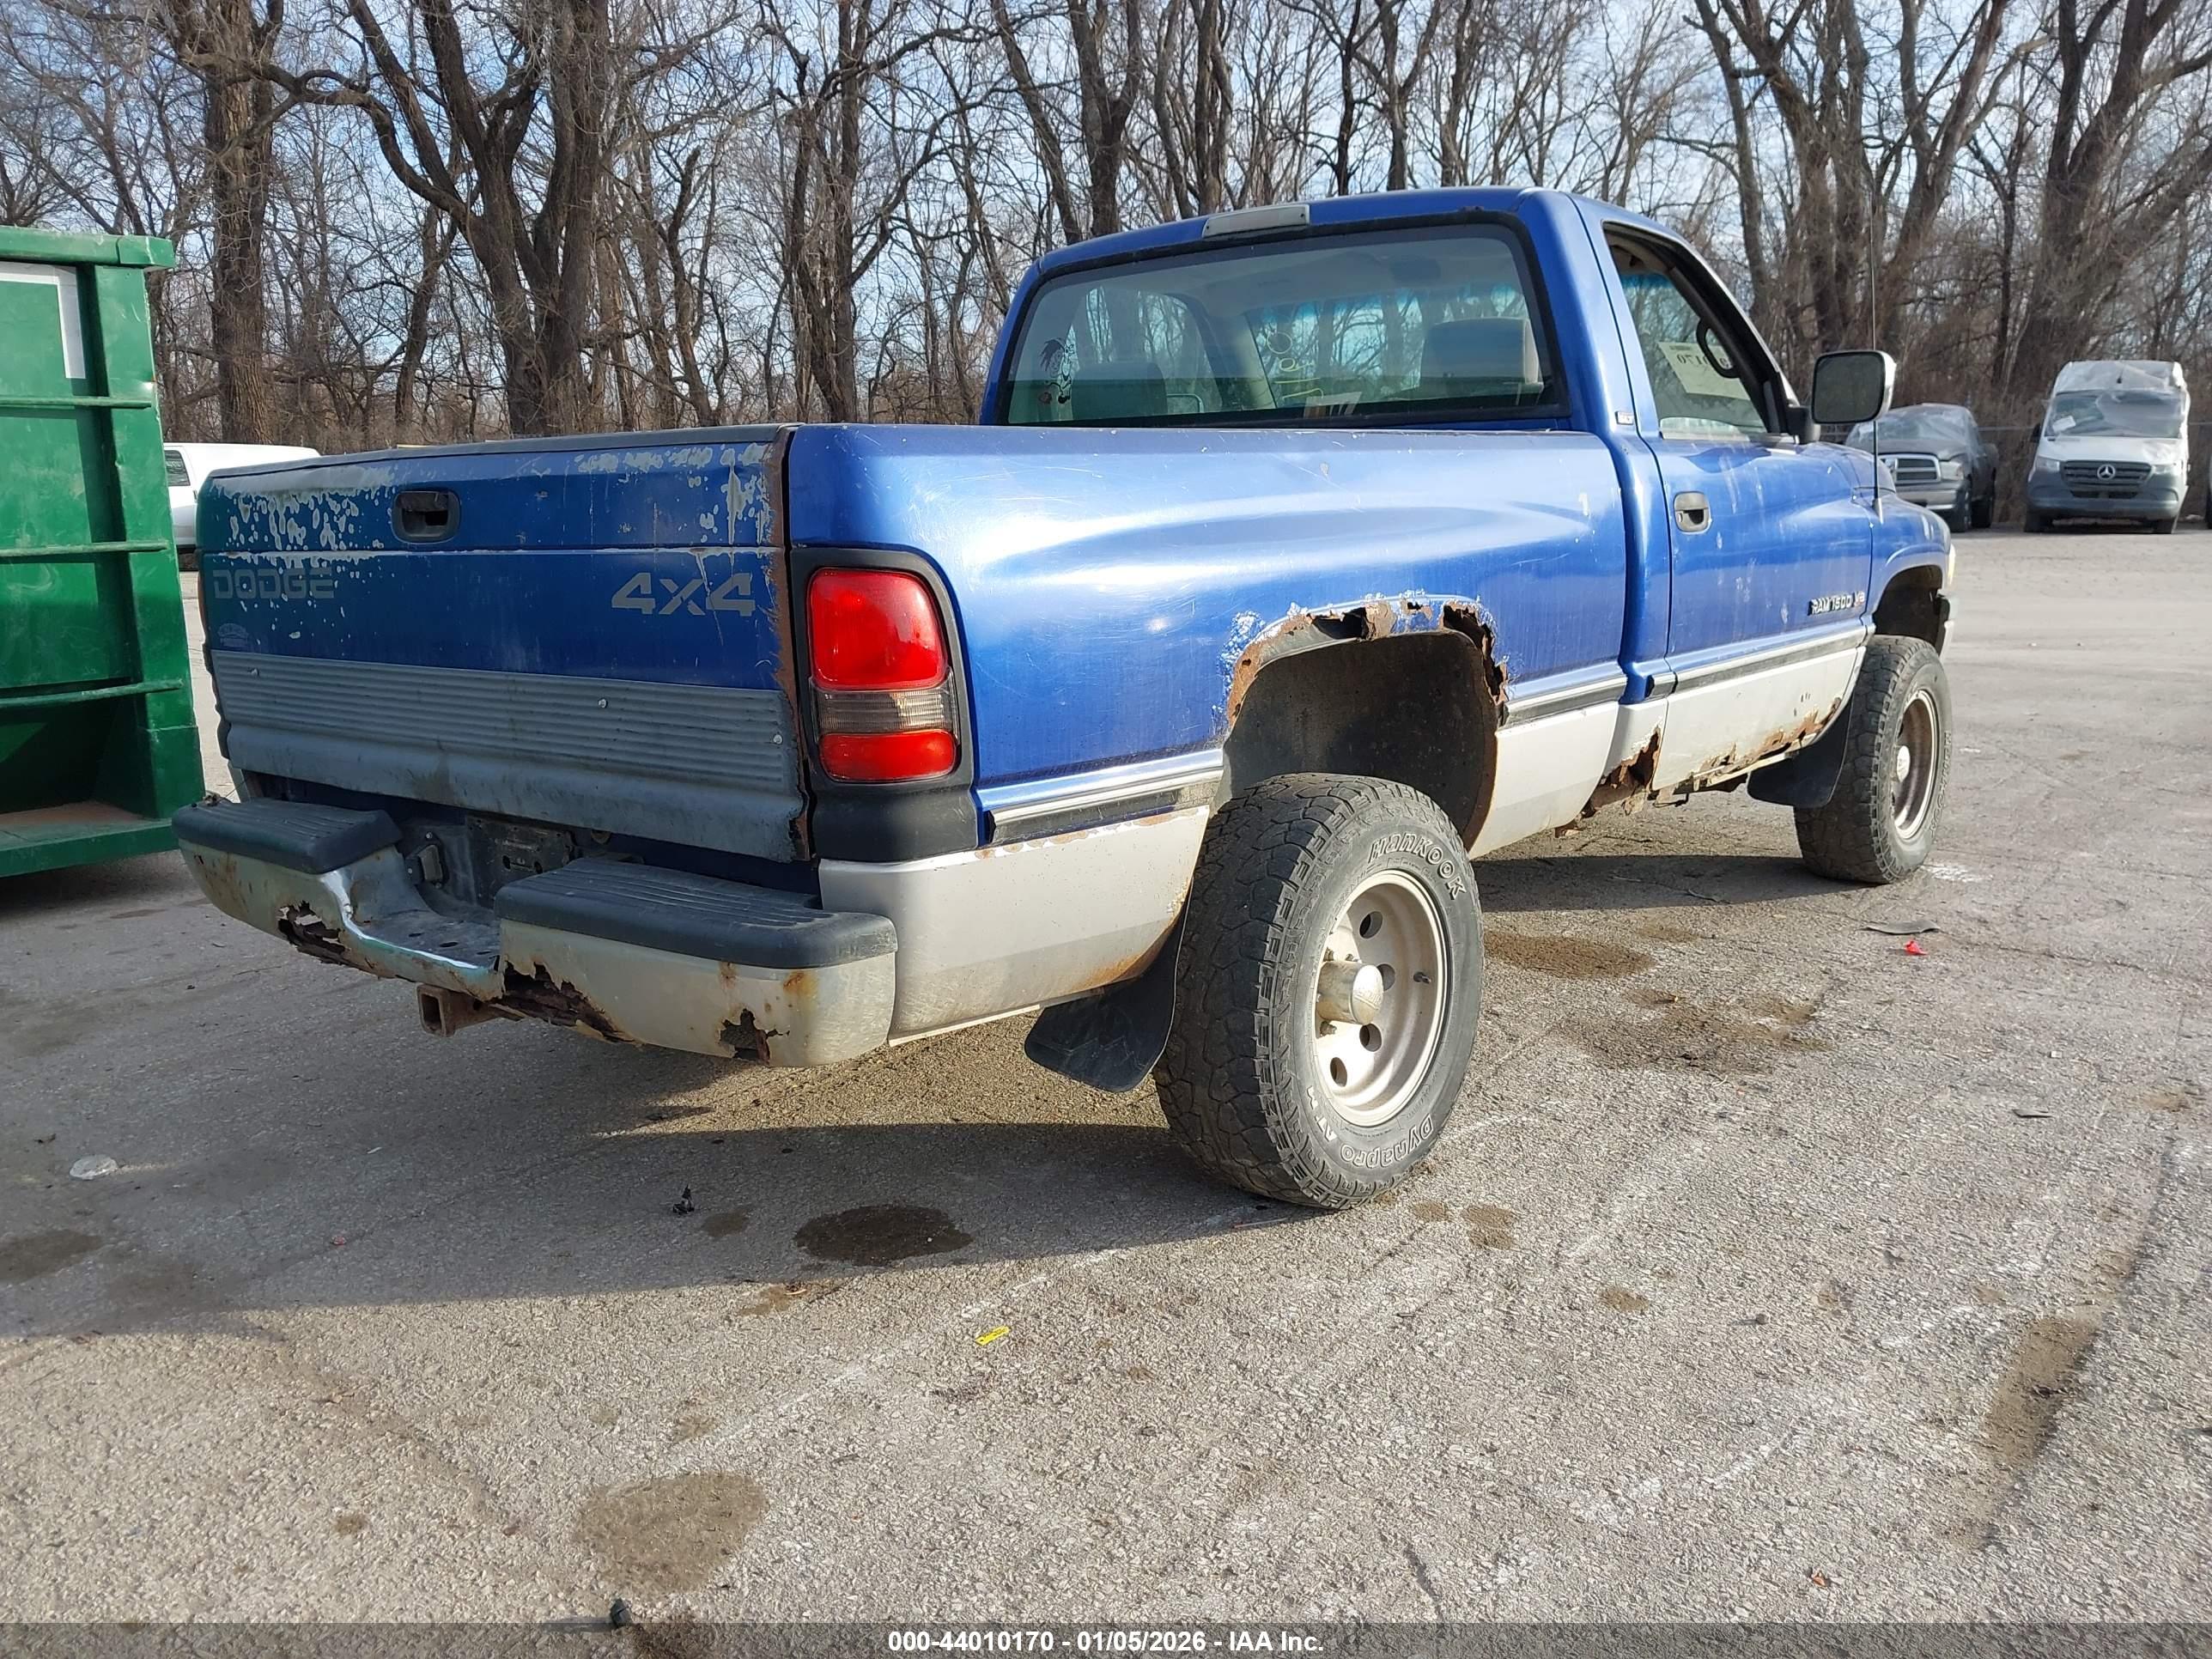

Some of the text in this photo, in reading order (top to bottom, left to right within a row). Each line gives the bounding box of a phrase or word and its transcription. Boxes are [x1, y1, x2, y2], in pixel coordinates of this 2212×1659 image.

[212, 568, 335, 599] DODGE
[1809, 598, 1831, 615] RAM
[1832, 594, 1853, 611] 1500
